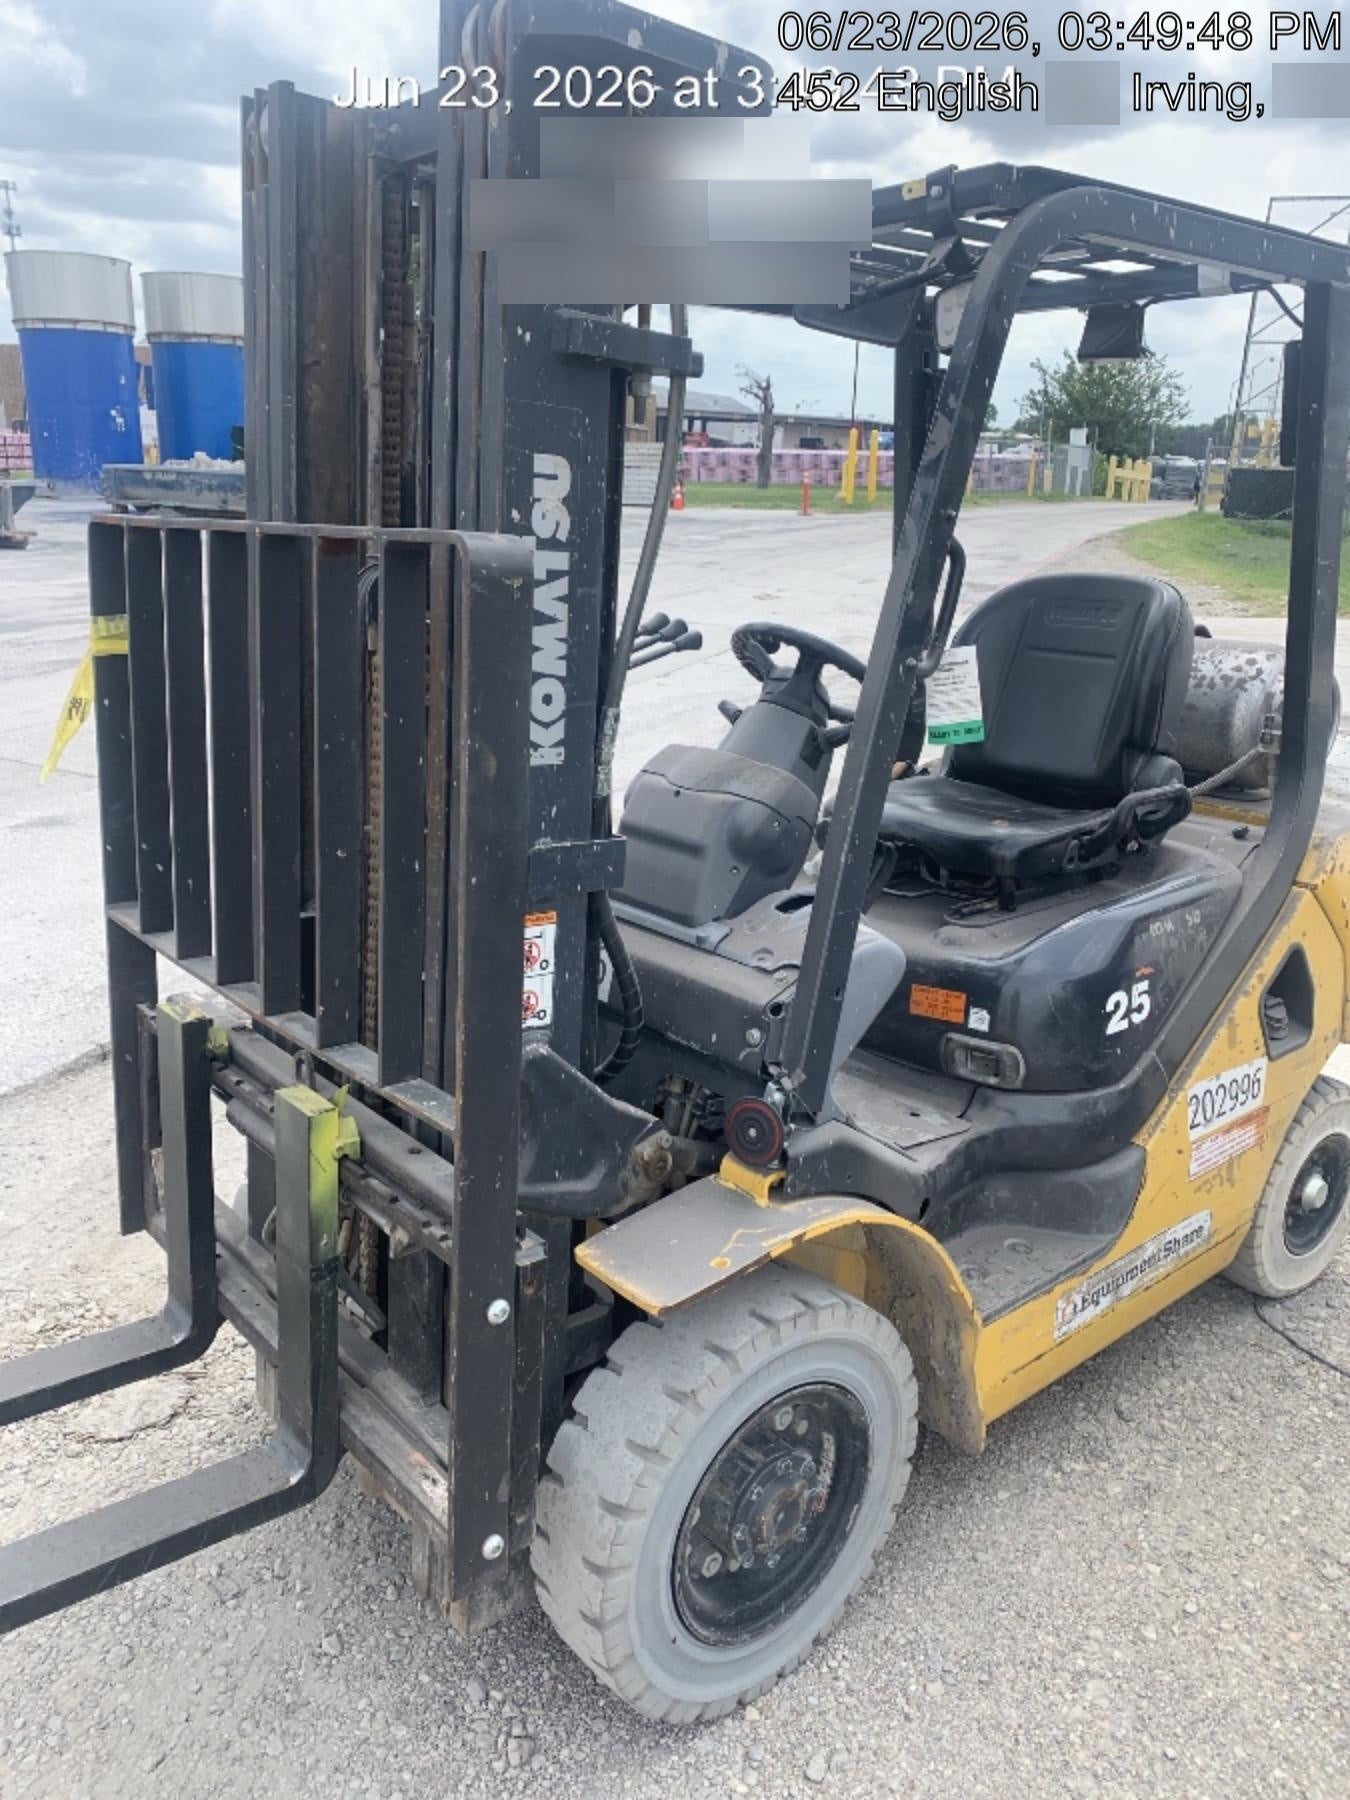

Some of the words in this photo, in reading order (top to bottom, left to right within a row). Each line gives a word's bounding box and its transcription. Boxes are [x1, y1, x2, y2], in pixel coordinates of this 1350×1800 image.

[529, 453, 572, 767] KOMATSU
[1105, 979, 1151, 1036] 25
[1188, 1066, 1263, 1131] 202996
